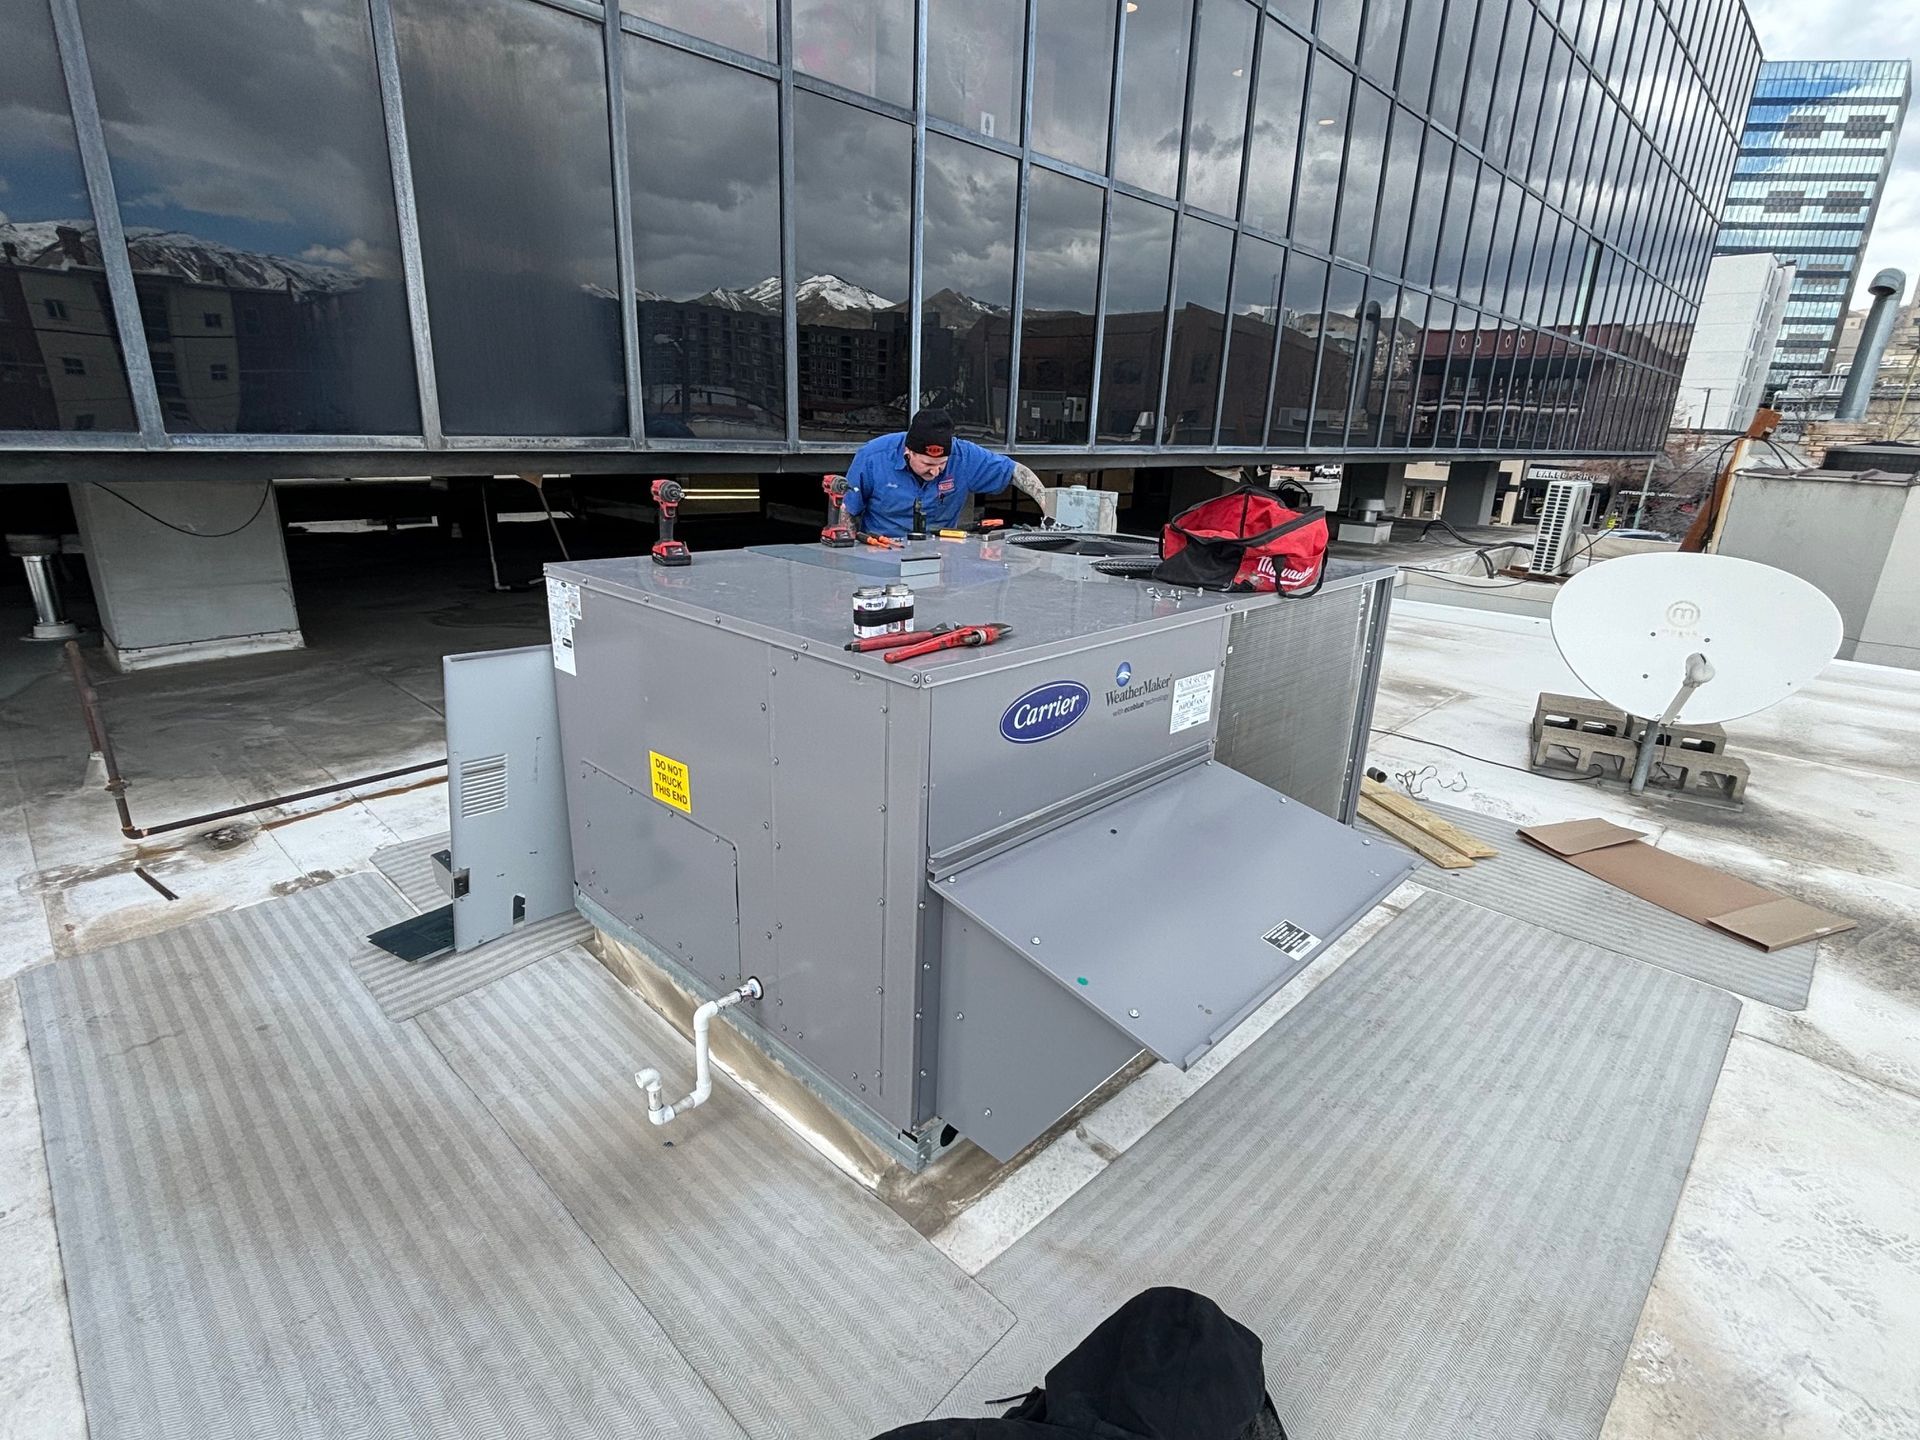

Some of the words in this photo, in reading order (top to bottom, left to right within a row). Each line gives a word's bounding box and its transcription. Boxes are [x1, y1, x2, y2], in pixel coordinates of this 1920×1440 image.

[1013, 694, 1080, 730] Carrier
[655, 759, 666, 771] DO
[668, 764, 683, 777] NOT
[657, 771, 683, 791] TRUCK
[655, 782, 671, 798] THIS
[672, 791, 688, 804] END
